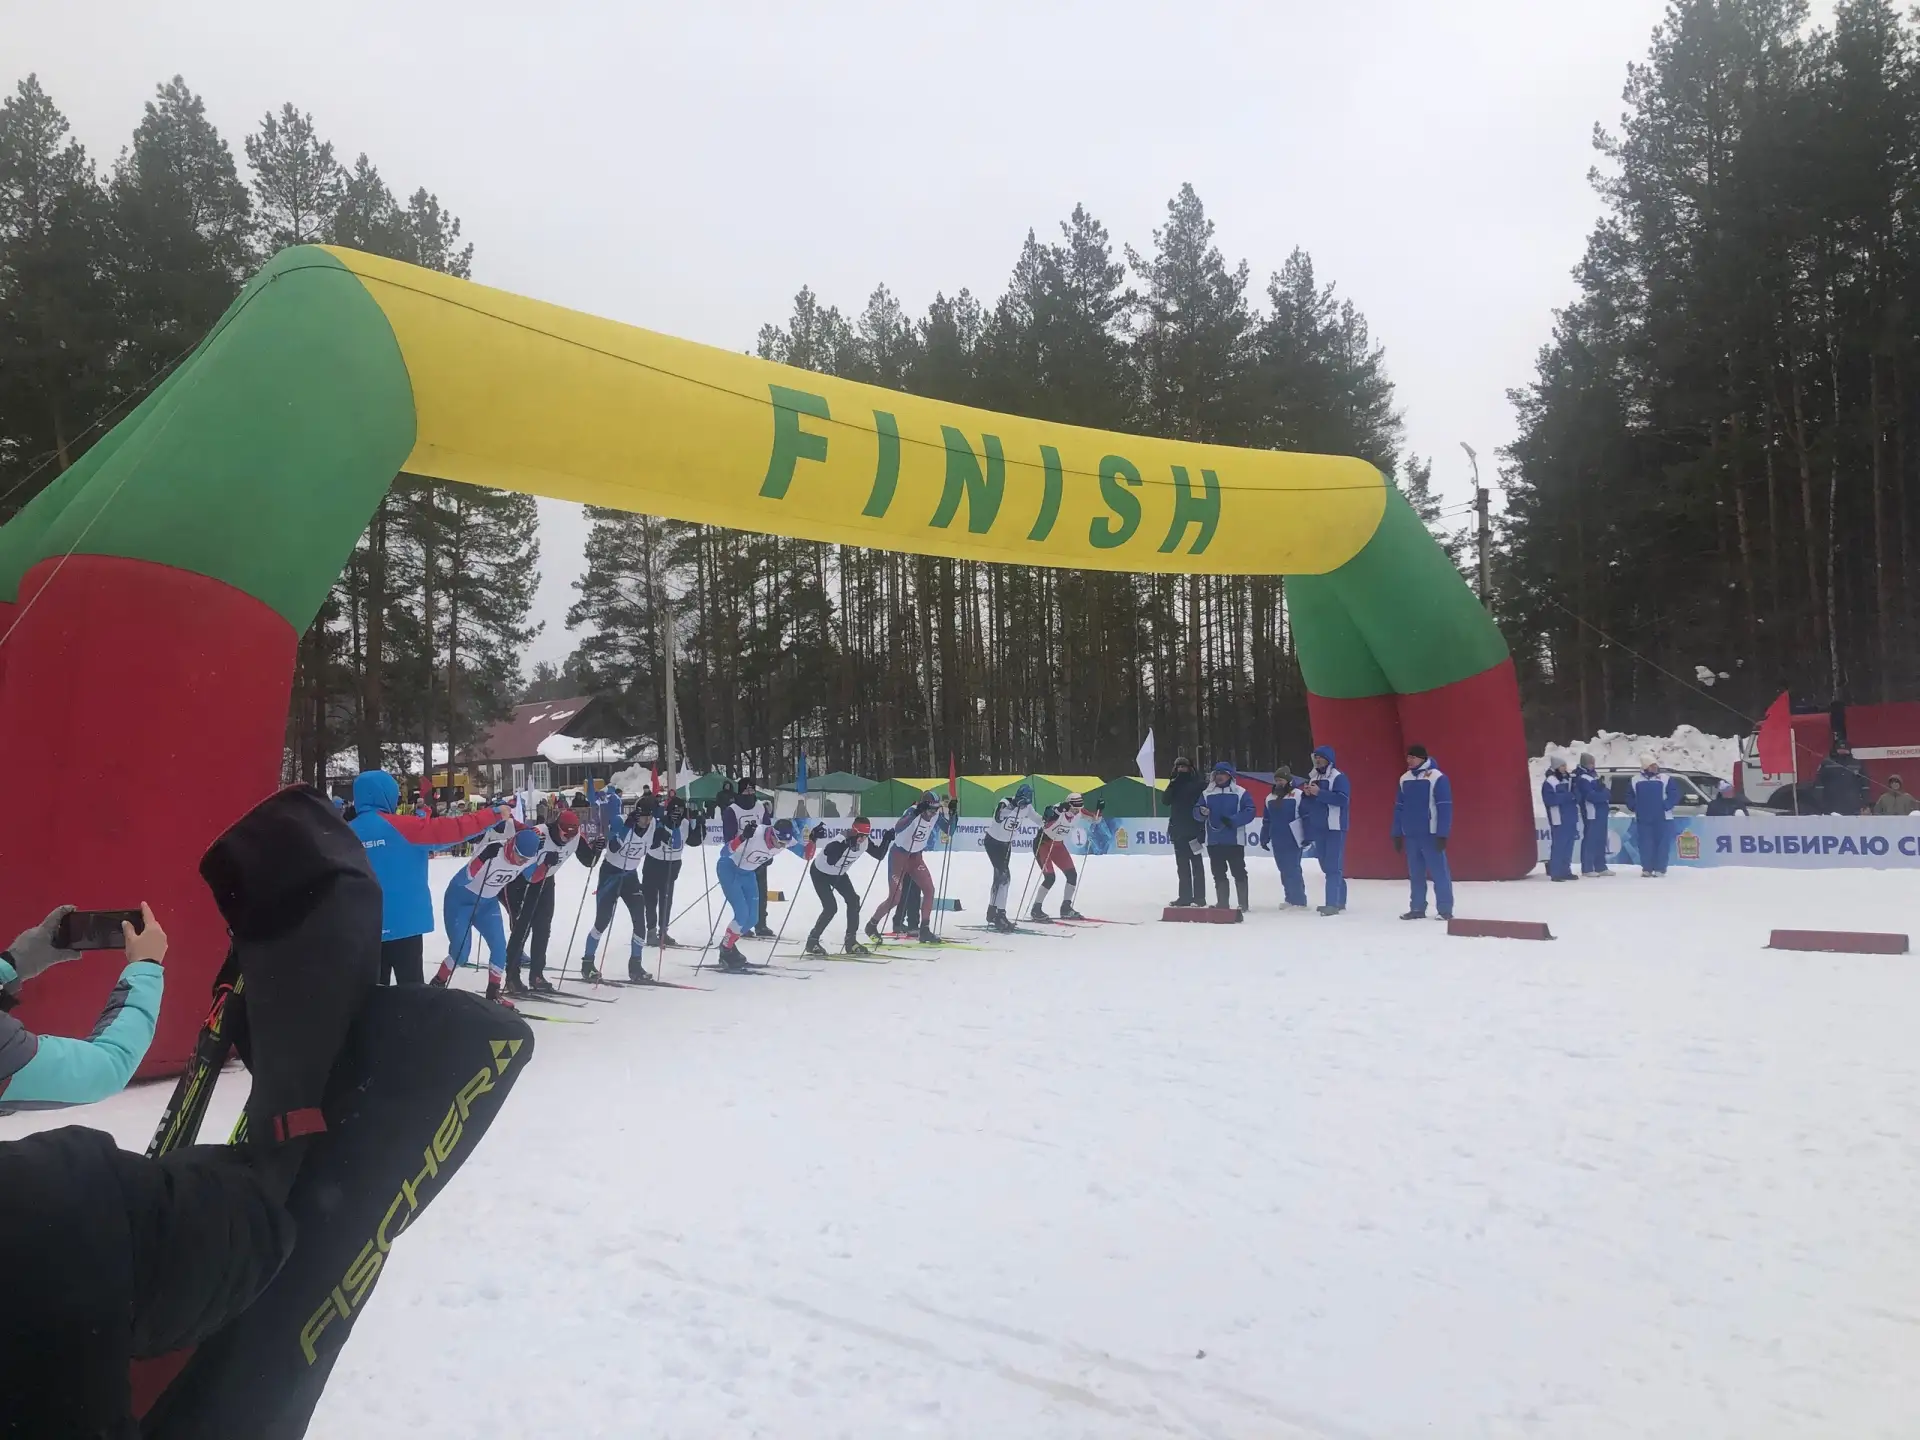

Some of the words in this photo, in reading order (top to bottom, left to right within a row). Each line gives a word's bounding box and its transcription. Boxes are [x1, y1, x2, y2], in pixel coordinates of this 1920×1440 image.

[758, 383, 1221, 554] FINISH
[1715, 836, 1732, 853] Я
[1740, 836, 1889, 855] ВЫБИРАЮ
[300, 1067, 495, 1365] FISCHER
